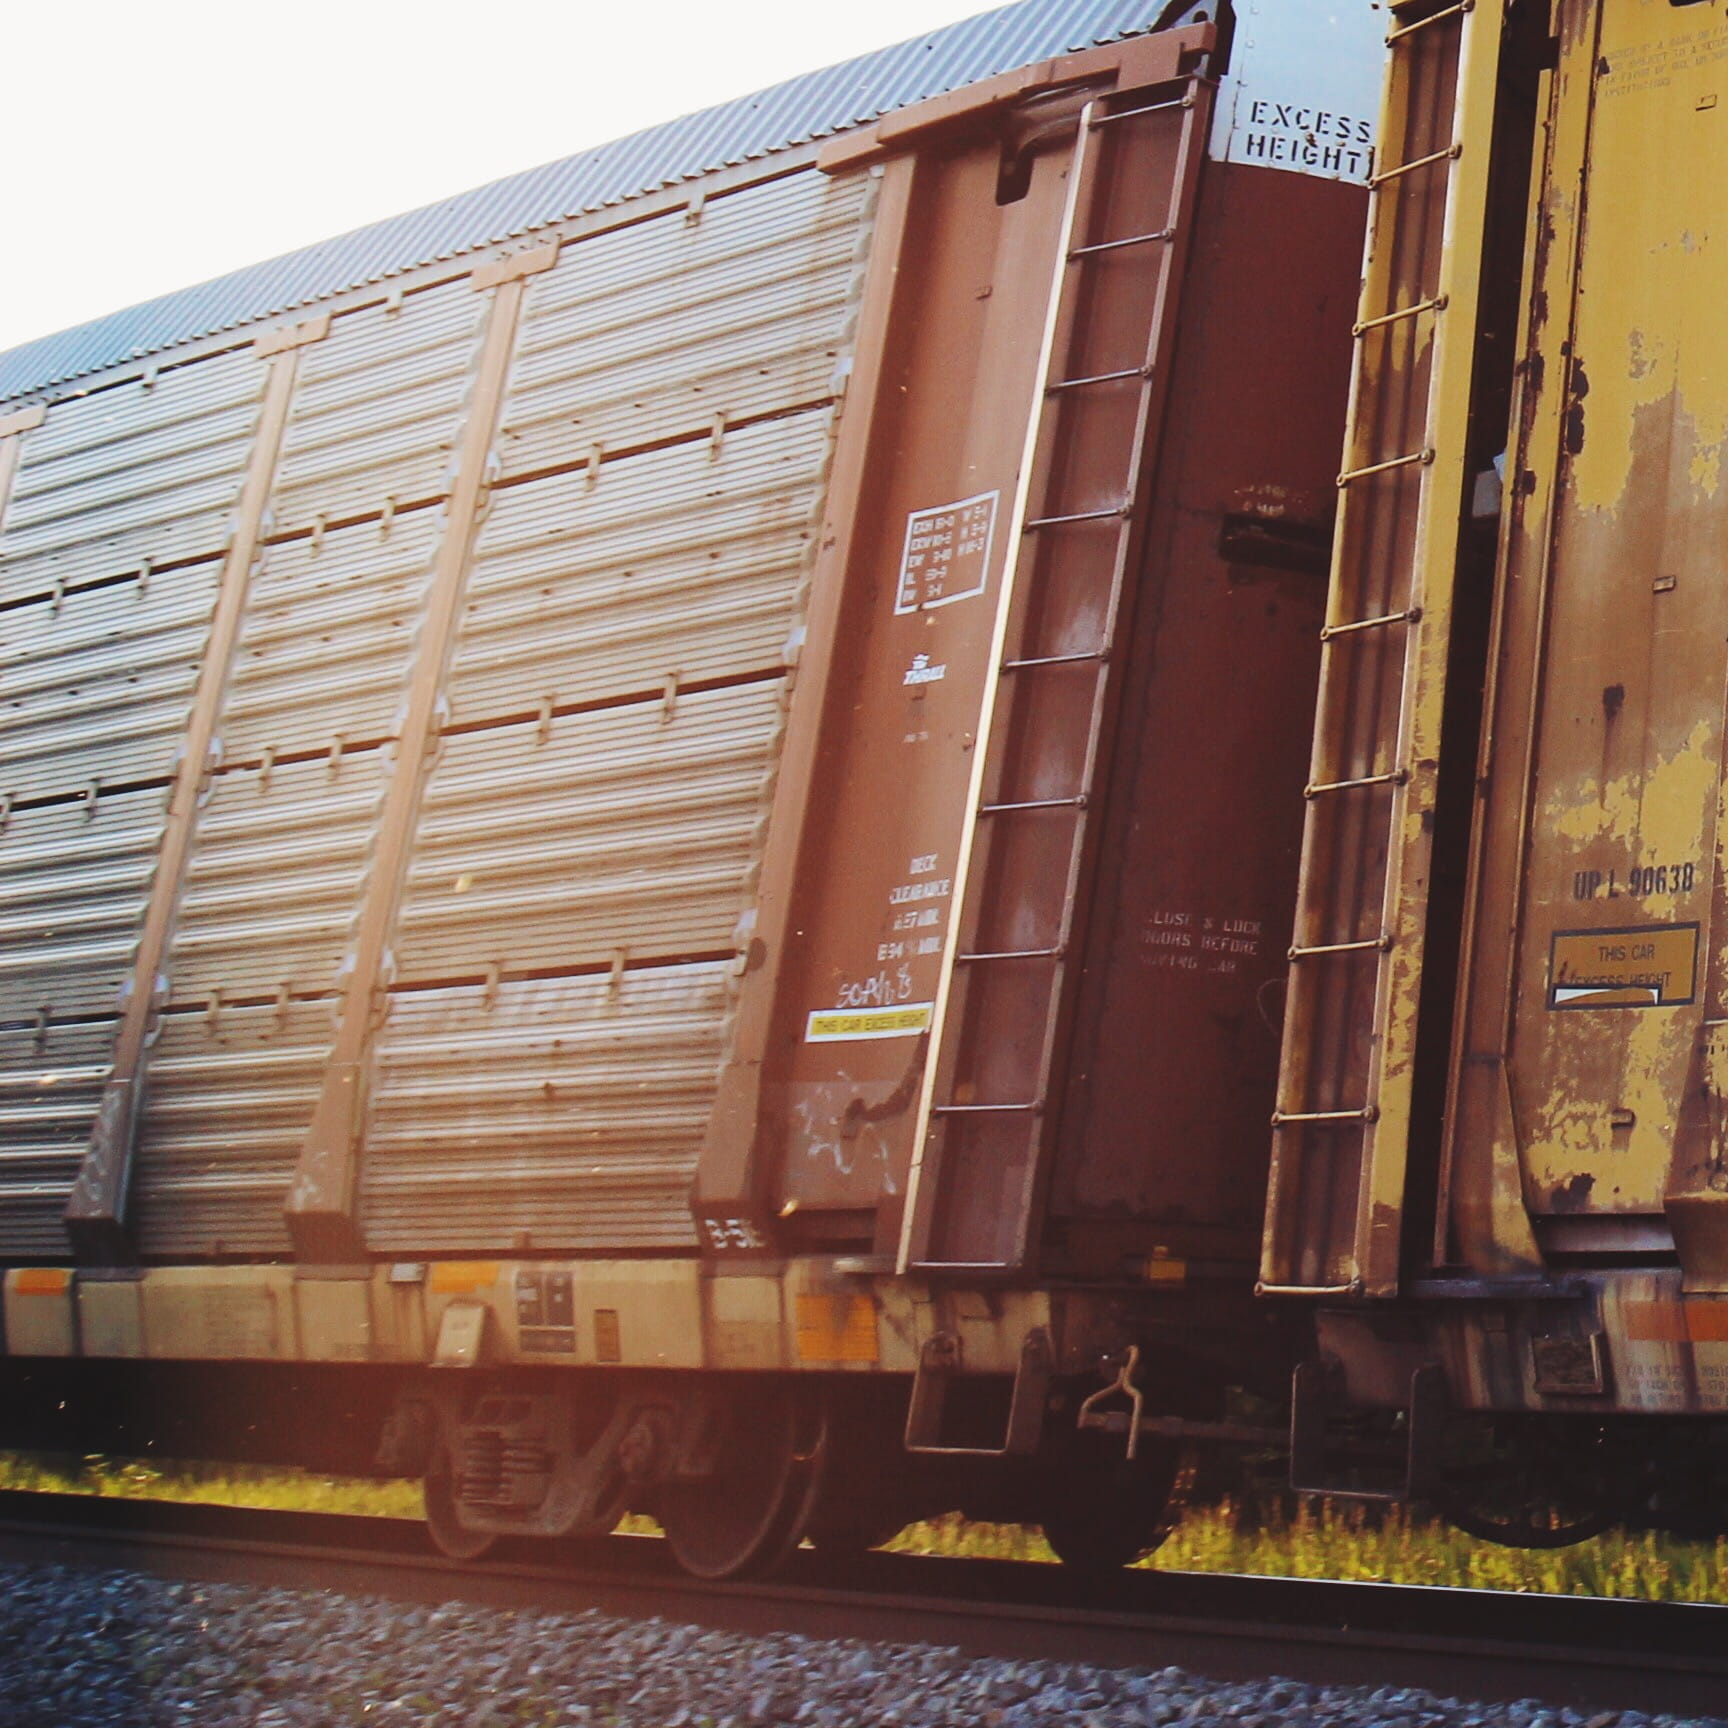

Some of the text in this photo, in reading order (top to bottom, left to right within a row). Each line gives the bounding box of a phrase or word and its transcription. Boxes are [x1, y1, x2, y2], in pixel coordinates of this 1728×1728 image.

[1250, 101, 1370, 143] EXCESS
[1246, 133, 1361, 174] HEIGHT
[1629, 861, 1694, 897] 90638
[1201, 935, 1259, 956] BEFORE
[1598, 943, 1656, 962] THIS CAR
